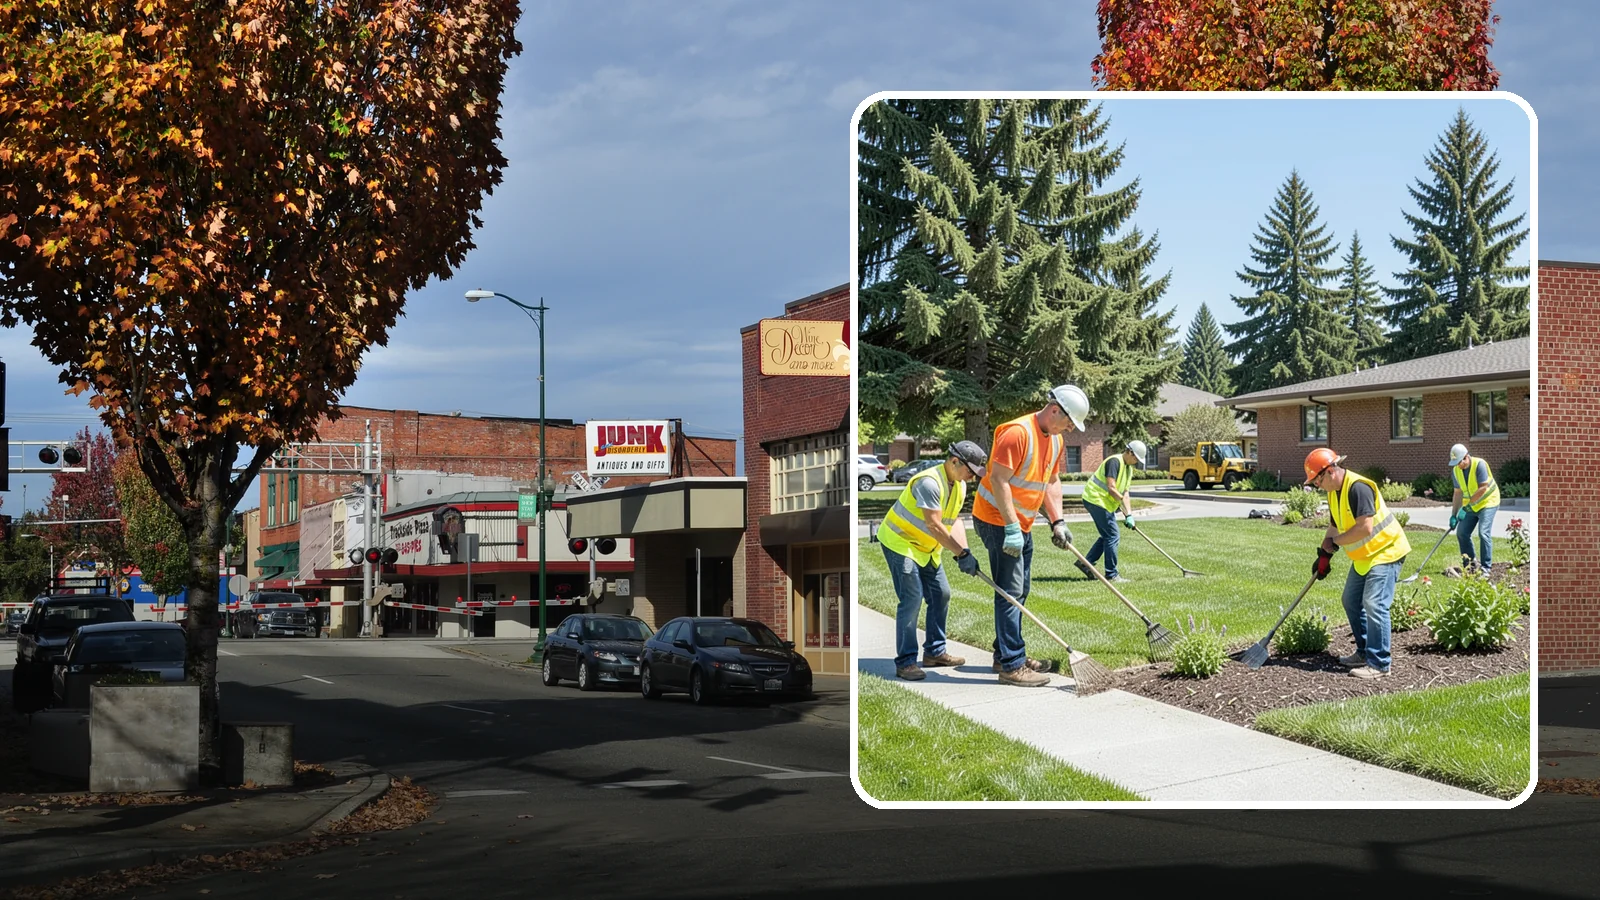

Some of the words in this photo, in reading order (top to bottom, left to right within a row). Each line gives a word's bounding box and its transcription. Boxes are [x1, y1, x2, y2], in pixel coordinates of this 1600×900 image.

[765, 327, 831, 365] Decor
[595, 425, 665, 457] JUNK
[607, 446, 646, 454] DISORDERLY
[597, 461, 628, 470] ANTIQUES
[631, 461, 644, 470] AND
[647, 461, 665, 470] GIFTS
[414, 520, 429, 535] Pizza
